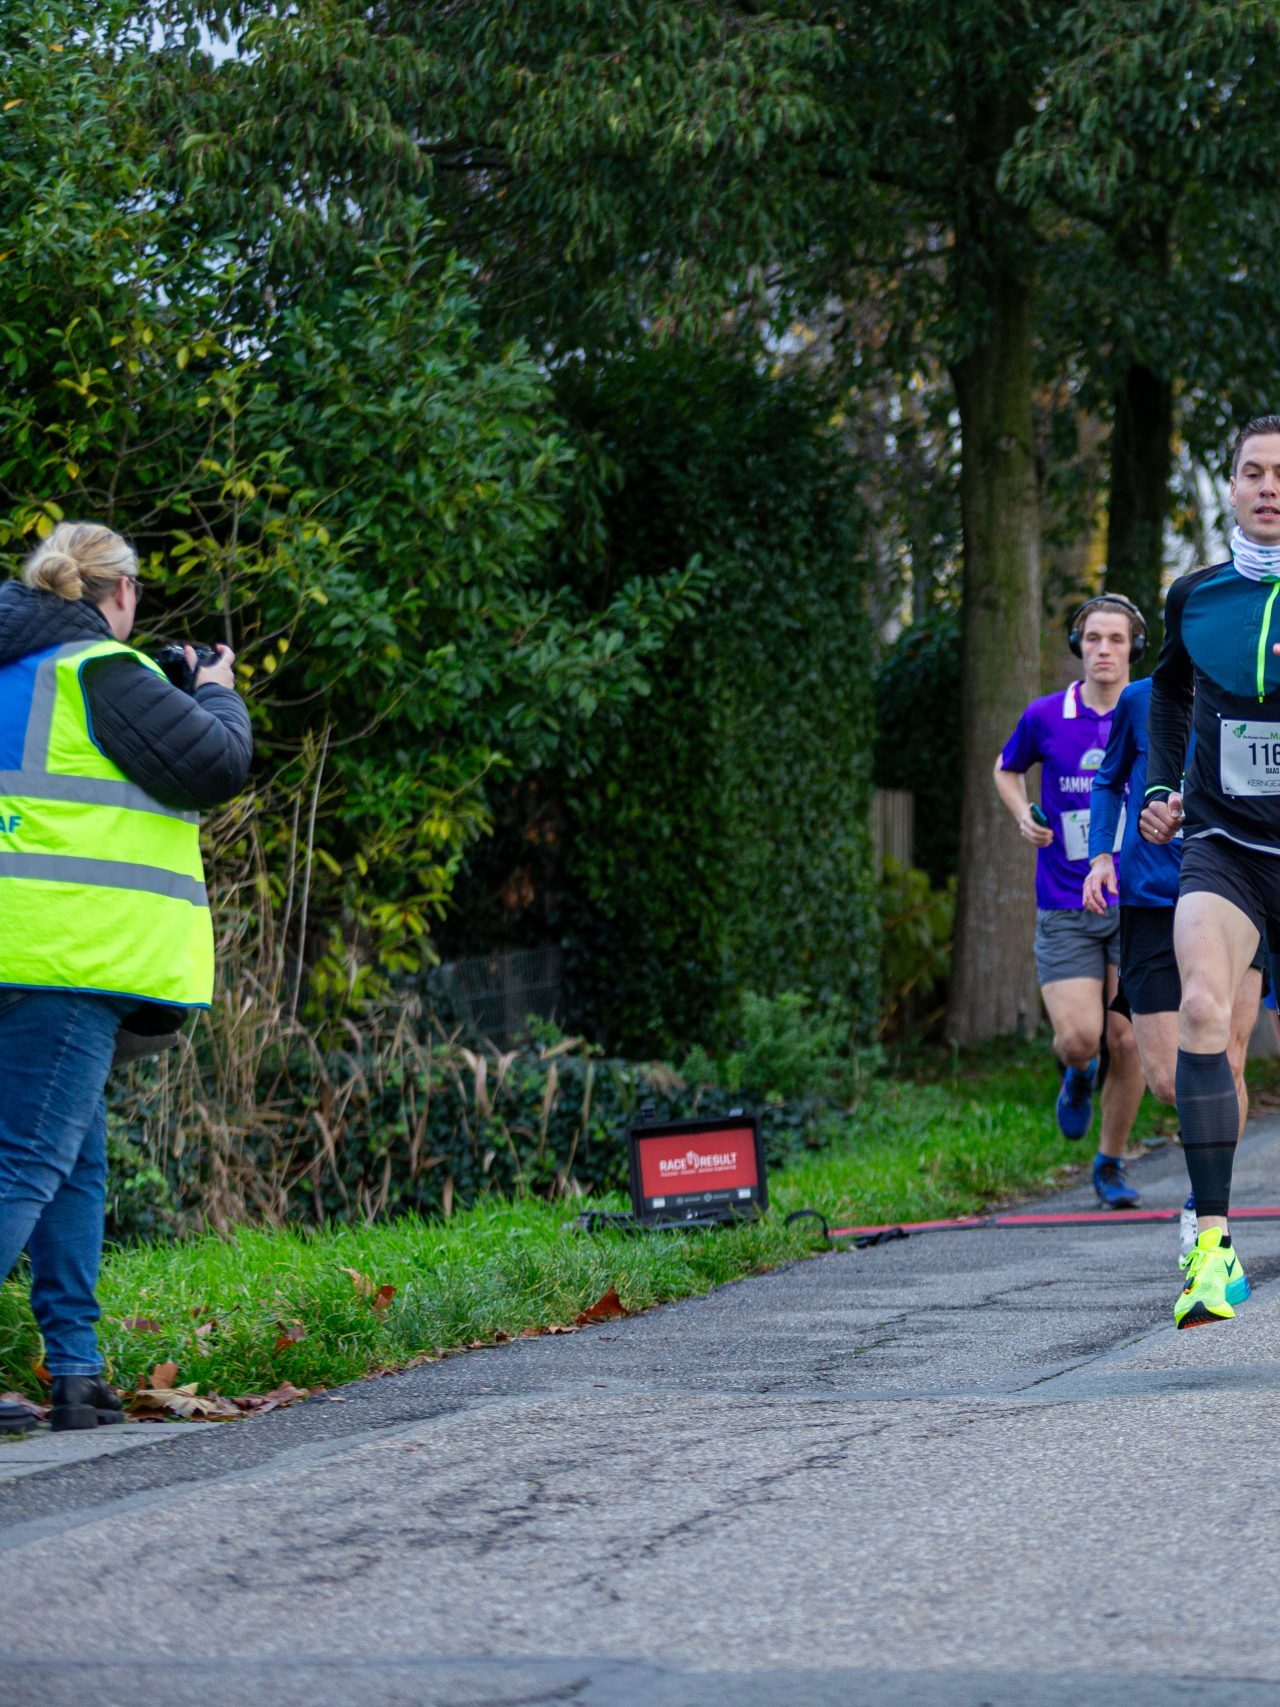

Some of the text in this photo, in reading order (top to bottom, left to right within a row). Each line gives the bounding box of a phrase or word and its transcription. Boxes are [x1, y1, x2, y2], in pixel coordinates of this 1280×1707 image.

[1265, 767, 1280, 775] BAAS
[659, 1152, 738, 1171] RACE RESULT
